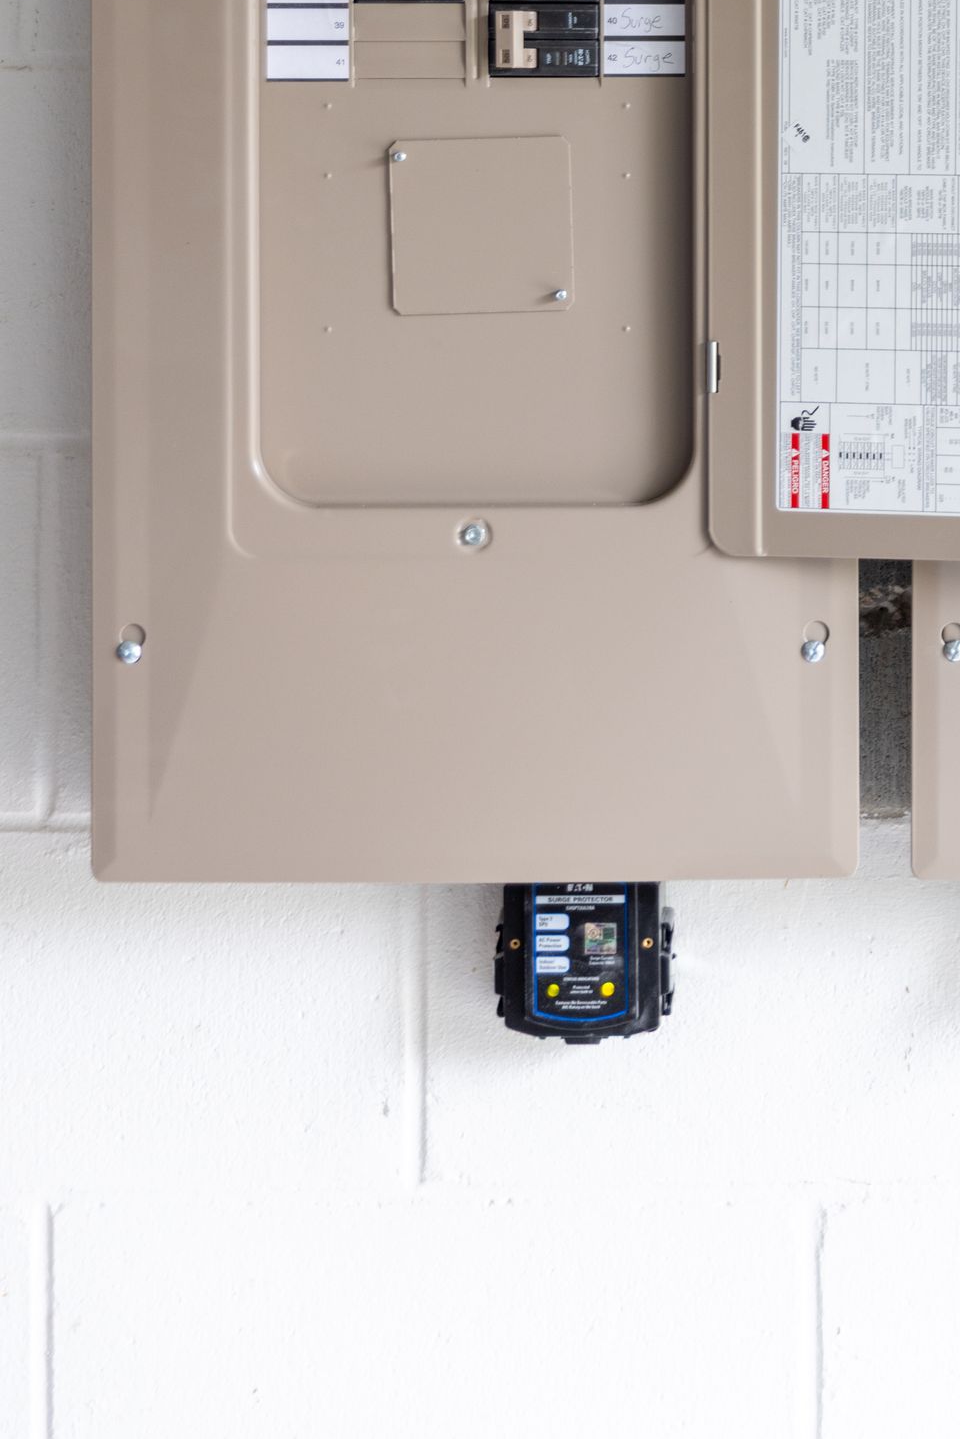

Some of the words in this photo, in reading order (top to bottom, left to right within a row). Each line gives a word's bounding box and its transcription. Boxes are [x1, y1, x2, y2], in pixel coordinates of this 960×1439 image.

[334, 21, 345, 29] 39
[607, 17, 618, 25] 40
[620, 7, 664, 33] Surge
[335, 58, 345, 66] 41
[607, 54, 618, 62] 42
[623, 47, 675, 72] Surge
[791, 459, 799, 495] PELIGRO
[822, 460, 830, 494] DANGER
